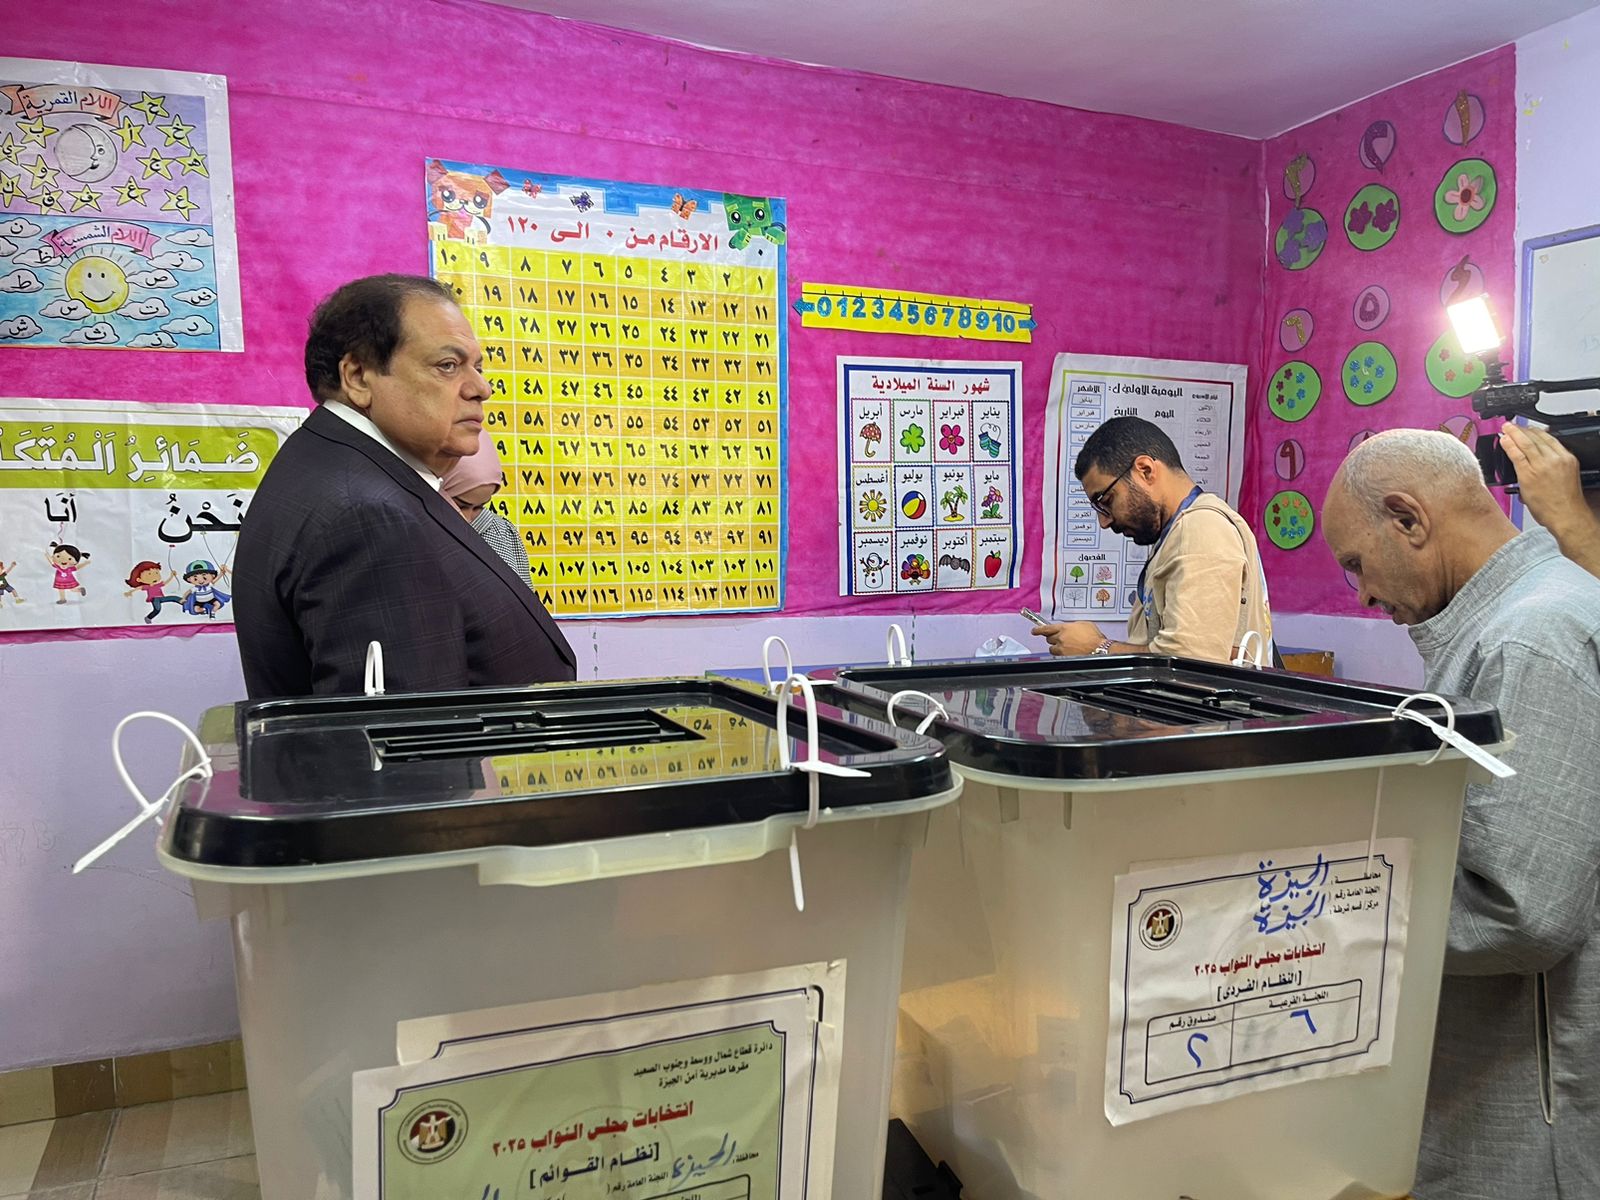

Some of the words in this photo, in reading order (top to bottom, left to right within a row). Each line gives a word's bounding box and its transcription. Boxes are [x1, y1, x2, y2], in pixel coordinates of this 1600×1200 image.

[23, 91, 77, 113] القمرية
[80, 93, 112, 110] اللام
[508, 216, 538, 234] ١٢٠
[625, 226, 655, 250] من
[659, 228, 718, 253] الارقام
[441, 249, 457, 265] ١٠
[480, 251, 489, 268] ٩
[521, 257, 531, 272] ٨
[562, 260, 572, 274] ٧
[594, 263, 604, 277] ٦
[625, 266, 633, 278] ٥
[661, 267, 668, 282] ٤
[688, 270, 696, 284] ٣
[723, 273, 731, 287] ٢
[758, 276, 763, 290] ١
[817, 297, 832, 317] 0
[837, 297, 847, 317] 1
[853, 299, 866, 318] 2
[872, 299, 884, 319] 3
[889, 302, 903, 321] 4
[908, 305, 920, 324] 5
[925, 306, 938, 325] 6
[942, 308, 954, 326] 7
[958, 308, 972, 328] 8
[975, 311, 990, 330] 9
[993, 313, 1016, 333] 10
[872, 375, 921, 394] الميلادية
[927, 377, 955, 391] السنة
[962, 378, 990, 395] شهور
[524, 411, 542, 425] ٥٨
[859, 403, 883, 420] أبريل
[900, 404, 923, 418] مارس
[939, 405, 965, 420] فبراير
[980, 405, 1001, 420] يناير
[488, 411, 507, 427] ٥٩
[562, 413, 580, 428] ٥٧
[594, 414, 613, 429] ٥٦
[627, 416, 643, 428] ٥٥
[663, 416, 679, 430] ٥٤
[692, 417, 709, 431] ٥٣
[725, 418, 742, 432] ٥٢
[758, 420, 772, 433] ٥١
[1280, 440, 1295, 481] ٩
[855, 470, 889, 486] أغسطس
[901, 469, 923, 484] يوليو
[942, 469, 964, 482] يونيو
[983, 470, 1000, 485] مايو
[857, 537, 889, 549] ديسمبر
[900, 534, 928, 549] نوفمبر
[942, 532, 968, 550] أكتوبر
[978, 535, 1007, 548] سبتمبر
[1254, 950, 1281, 969] مجلس
[1284, 942, 1326, 964] انتخابات
[1194, 963, 1217, 976] ٢٠٢٥
[1219, 955, 1252, 977] النواب
[1290, 1009, 1317, 1035] ٦
[633, 1101, 694, 1129] انتخابات
[587, 1117, 629, 1141] مجلس
[531, 1124, 583, 1153] النواب
[493, 1138, 526, 1157] ٢٠٢٥
